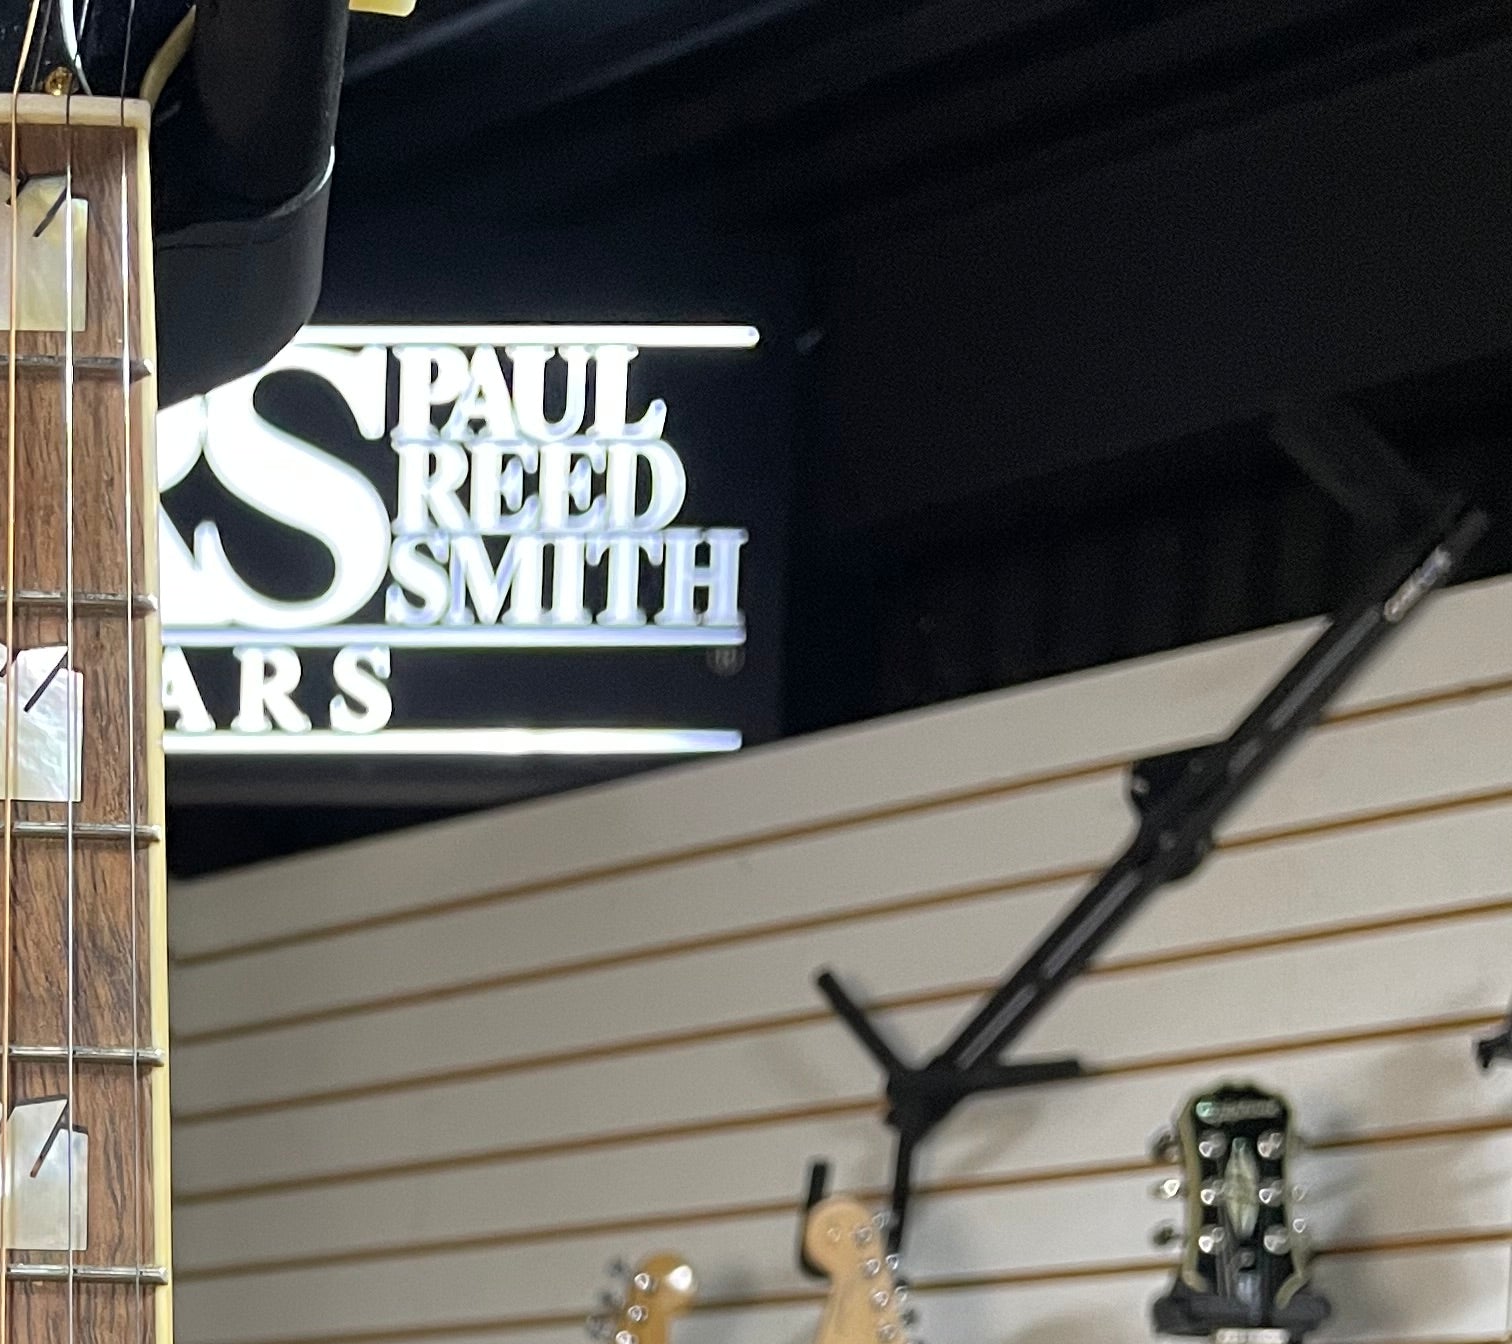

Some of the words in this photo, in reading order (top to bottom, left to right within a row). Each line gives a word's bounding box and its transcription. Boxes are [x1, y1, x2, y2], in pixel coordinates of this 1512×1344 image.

[392, 344, 666, 441] PAUL
[392, 437, 687, 536] REED
[386, 526, 749, 626] SMITH
